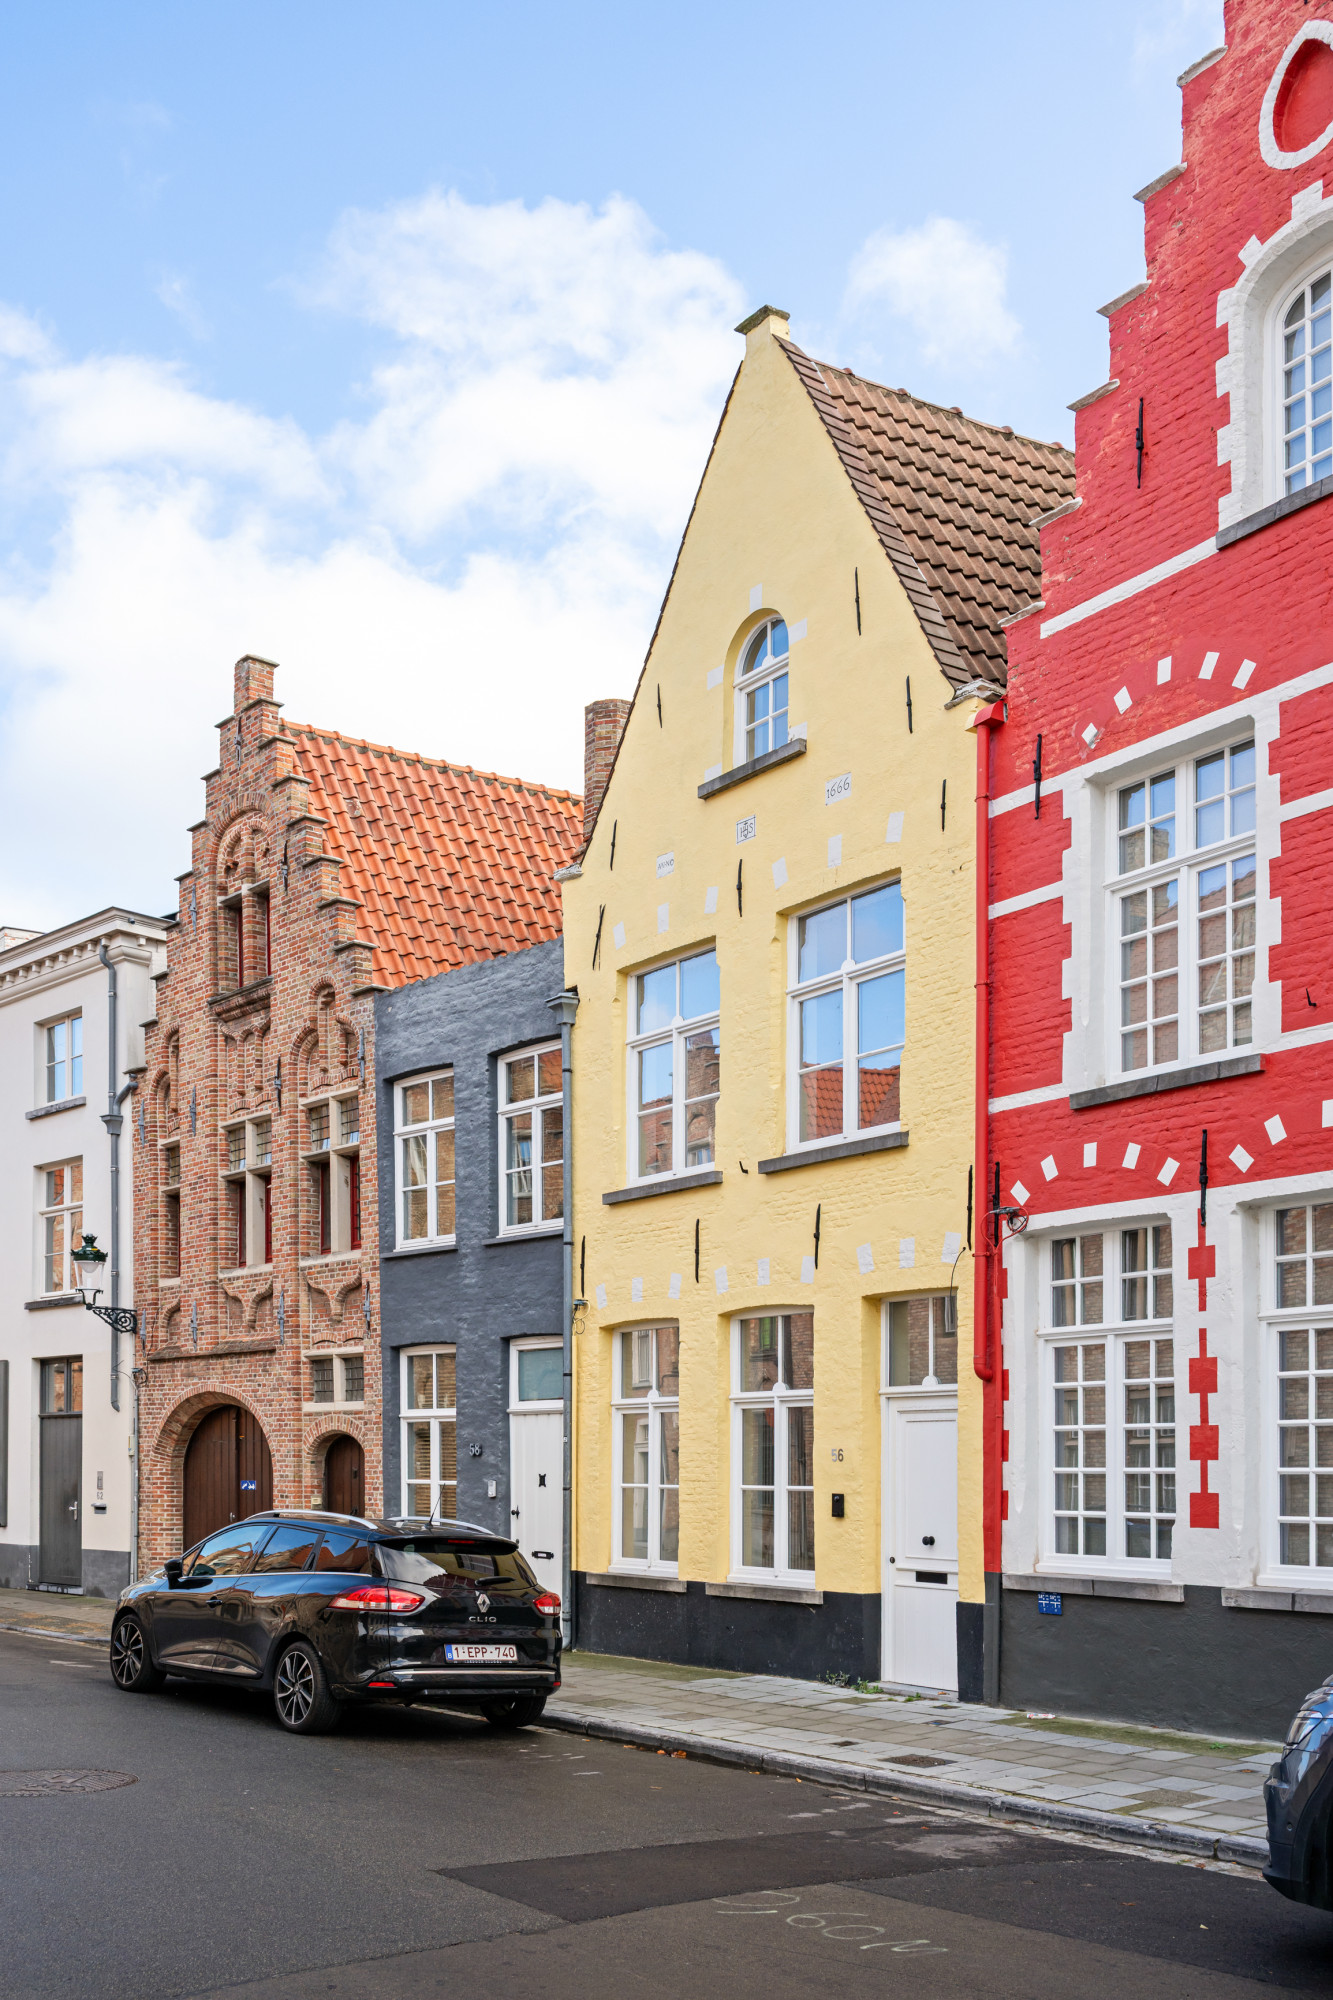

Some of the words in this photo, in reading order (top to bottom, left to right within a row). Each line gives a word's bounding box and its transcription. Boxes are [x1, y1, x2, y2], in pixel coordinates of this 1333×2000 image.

[827, 777, 850, 799] 1666
[469, 1443, 481, 1456] 58
[831, 1448, 844, 1462] 56
[96, 1491, 104, 1500] 62
